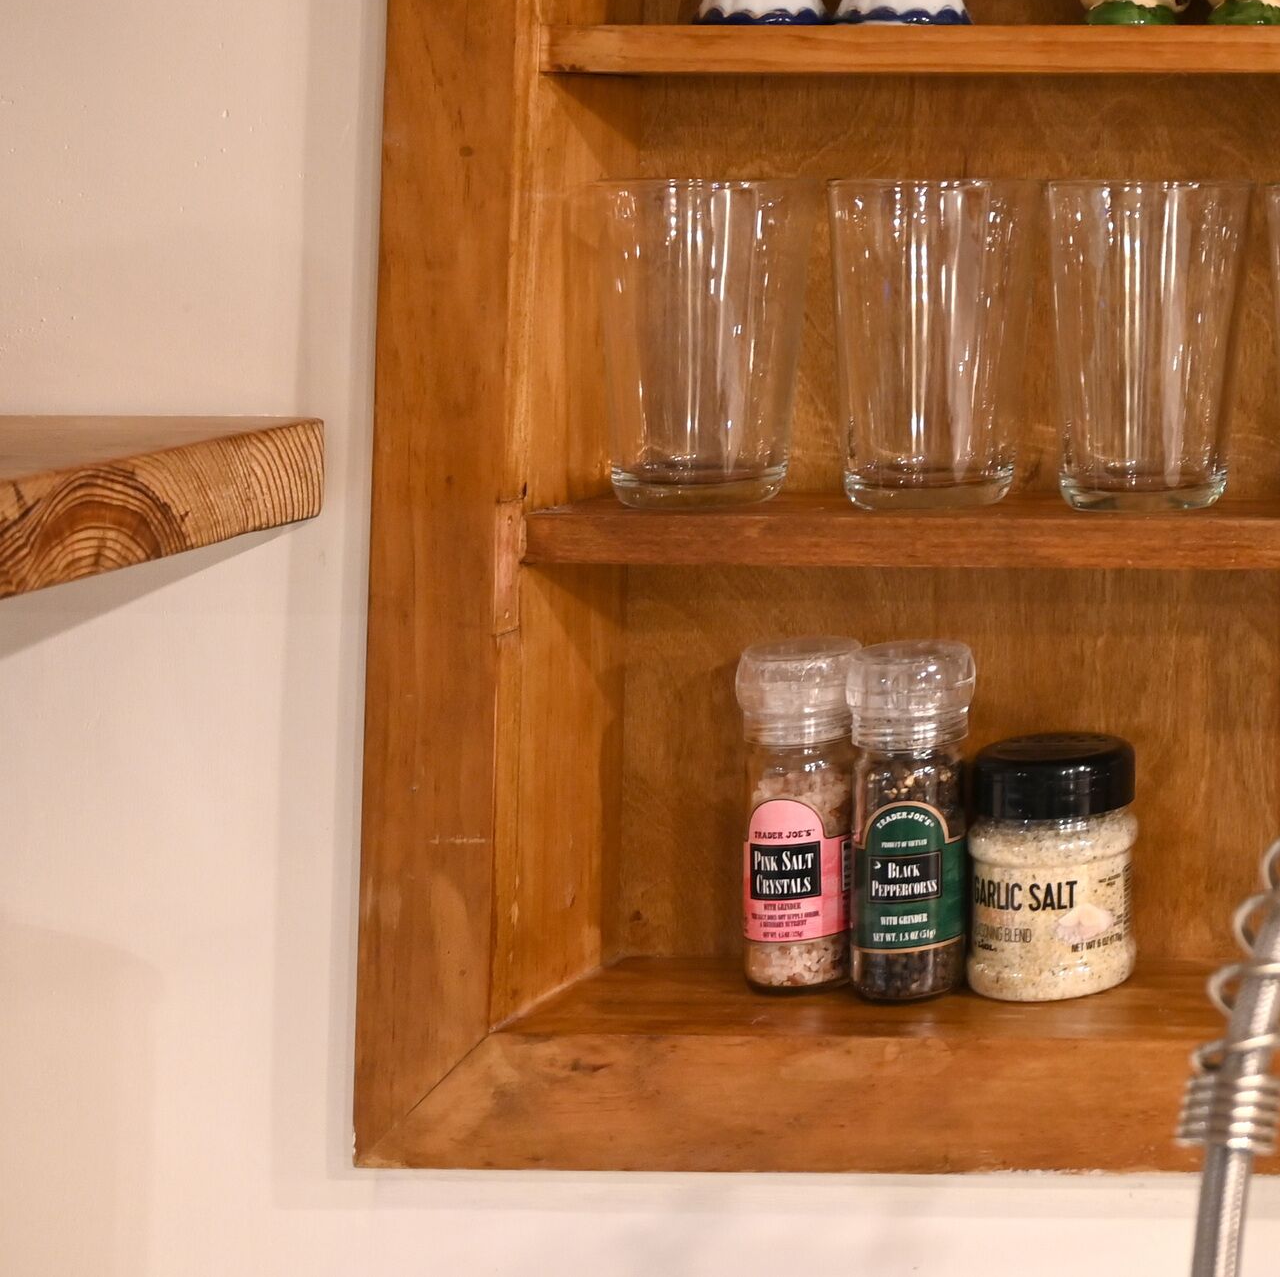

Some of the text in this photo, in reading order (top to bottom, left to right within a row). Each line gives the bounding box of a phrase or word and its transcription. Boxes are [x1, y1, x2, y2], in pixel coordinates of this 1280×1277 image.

[876, 812, 932, 829] TRADER JOE'S
[754, 829, 811, 839] TRADER JOE'S
[974, 876, 1078, 912] GARLIC SALT
[1004, 927, 1032, 943] BLEND
